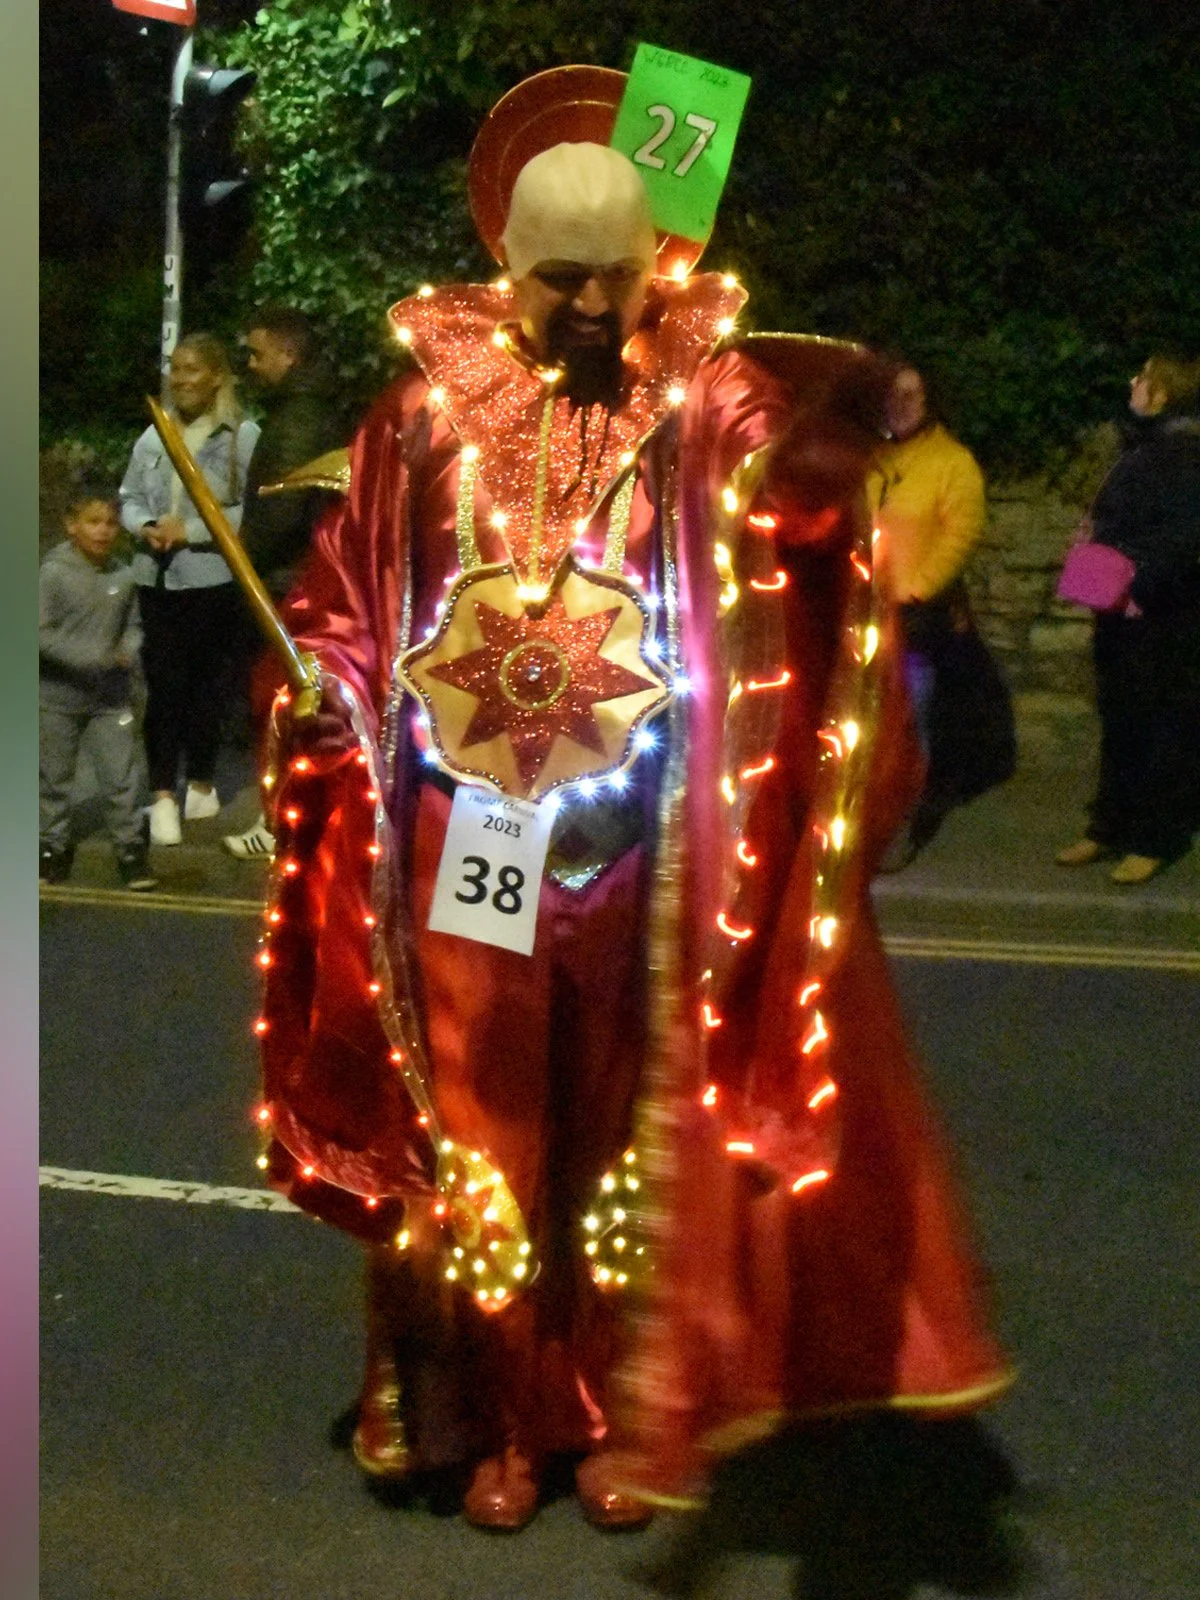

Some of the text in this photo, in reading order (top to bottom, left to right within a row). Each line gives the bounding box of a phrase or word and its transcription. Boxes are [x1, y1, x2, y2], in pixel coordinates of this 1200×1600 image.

[633, 104, 718, 178] 27
[482, 814, 522, 838] 2023
[455, 855, 525, 915] 38
